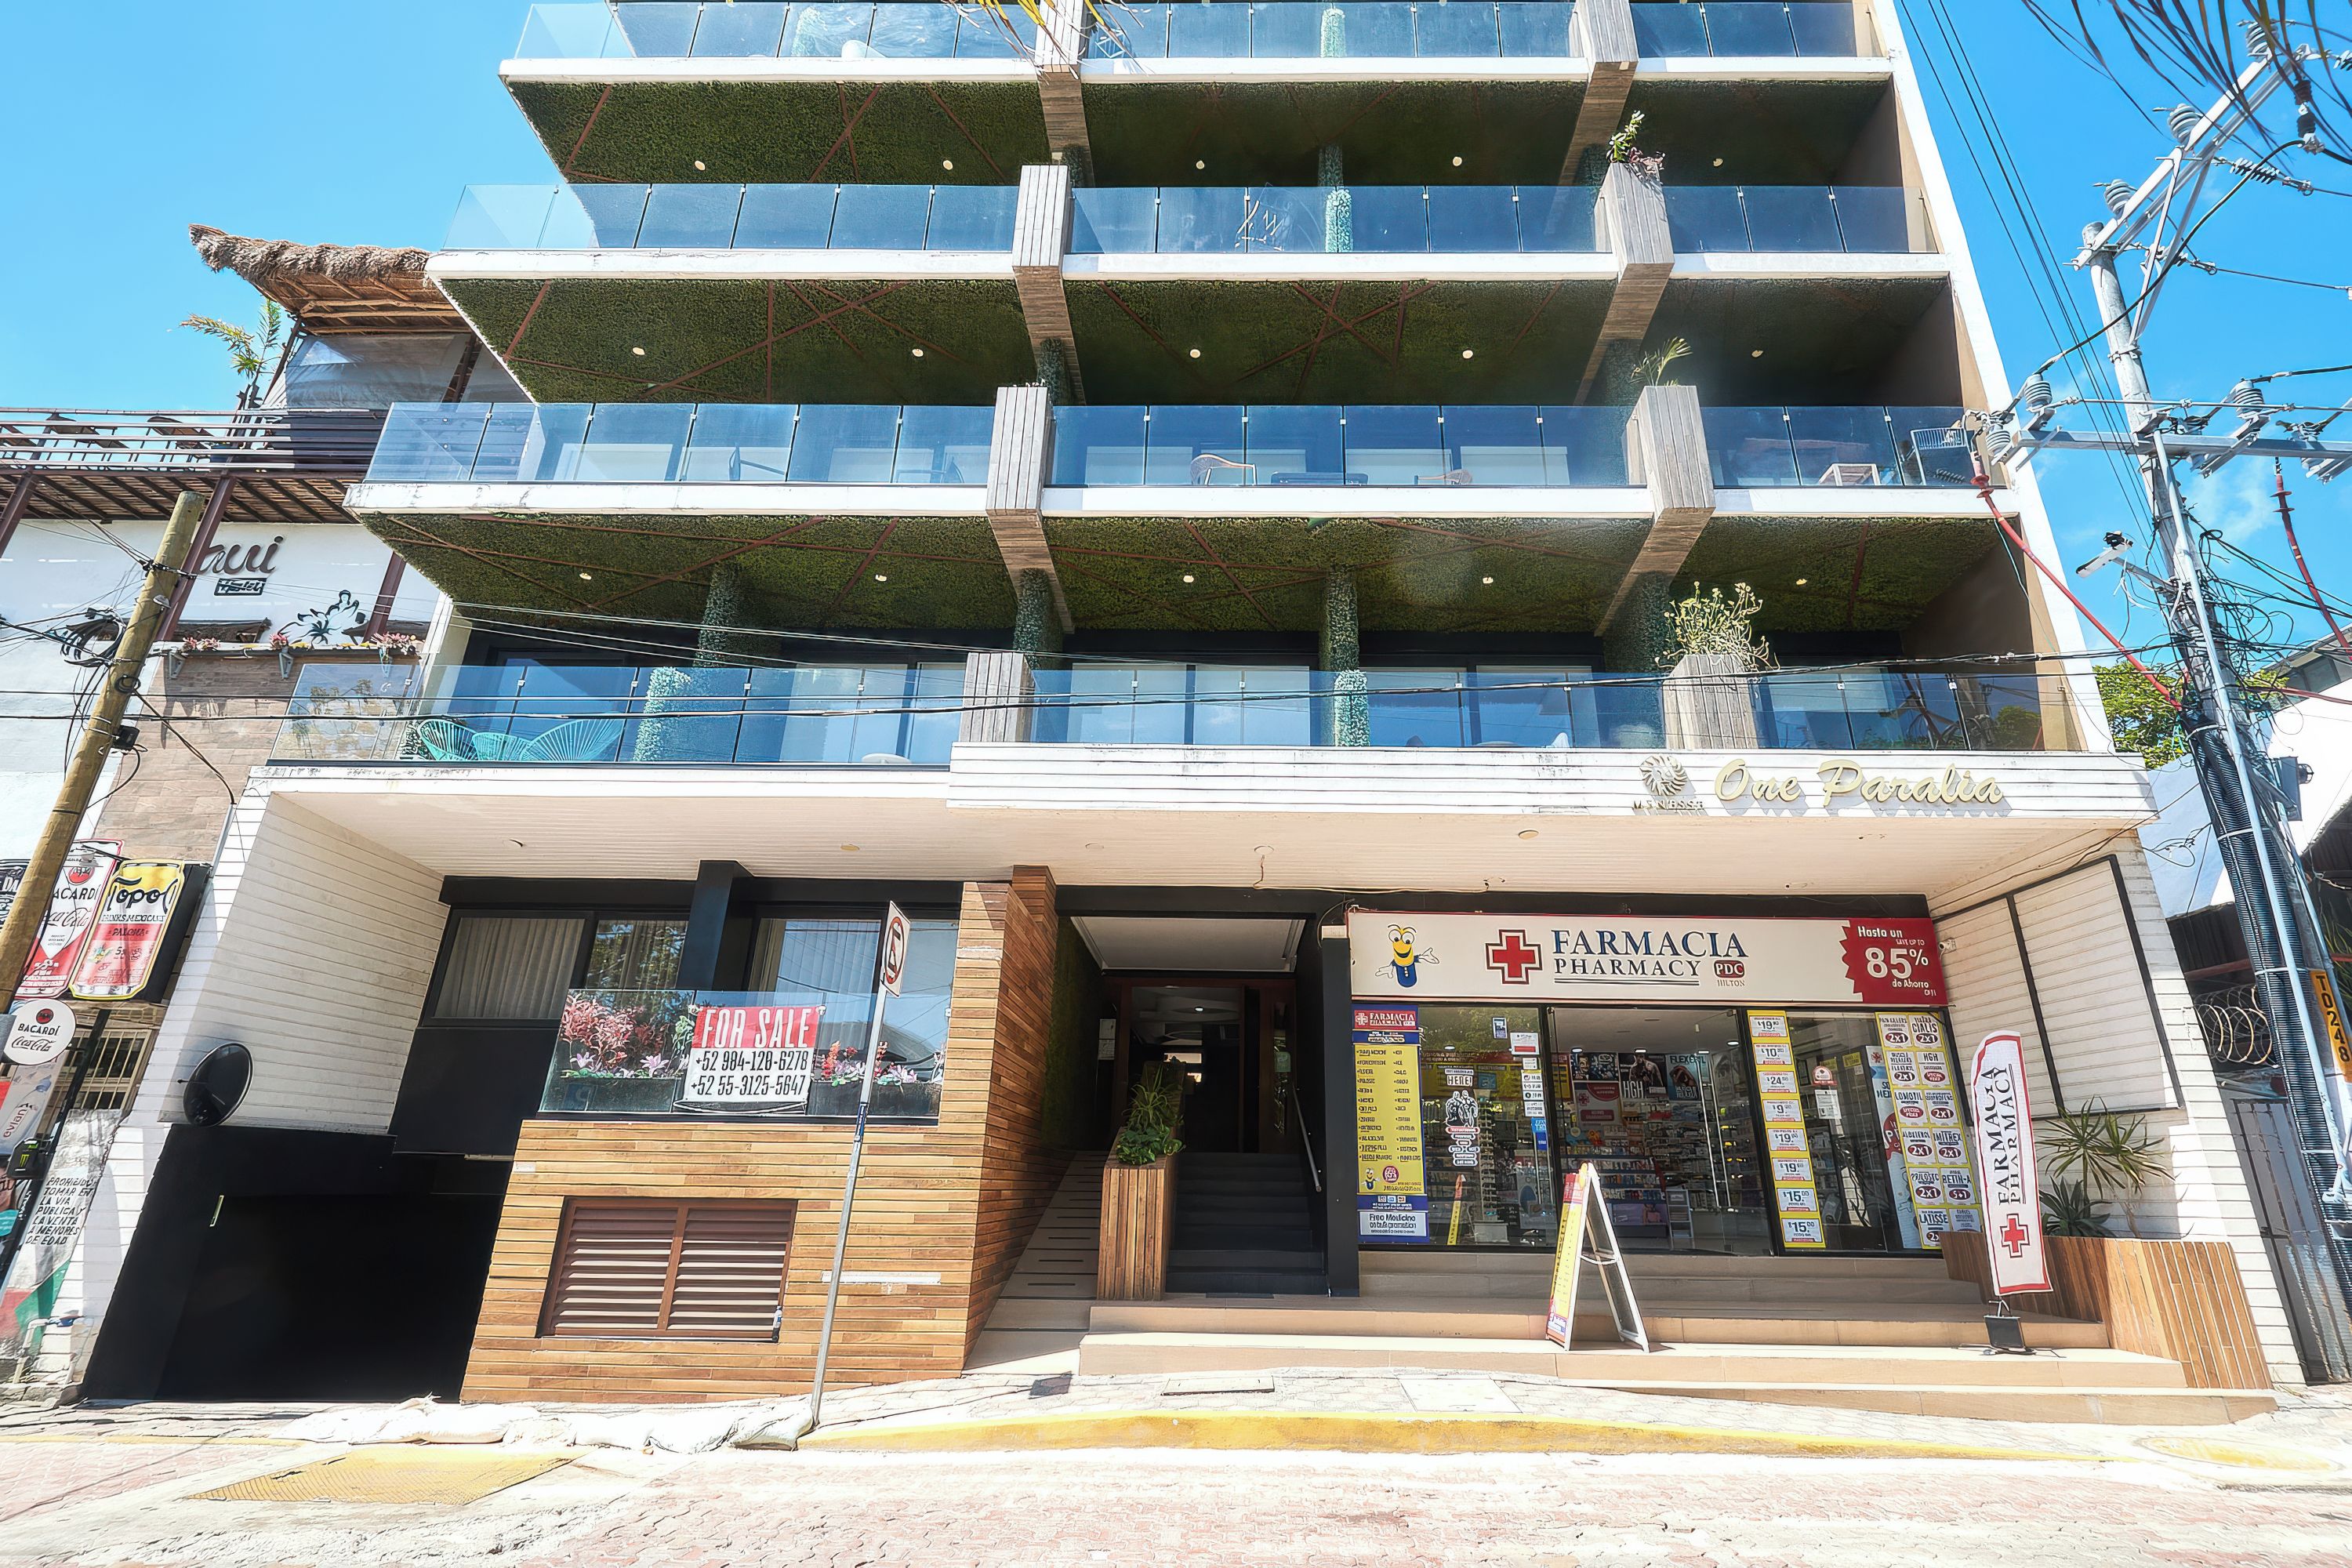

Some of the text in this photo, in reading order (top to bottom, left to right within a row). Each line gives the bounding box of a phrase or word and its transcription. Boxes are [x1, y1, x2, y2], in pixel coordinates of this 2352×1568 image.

[1714, 759, 2003, 807] One Paralia
[53, 884, 100, 901] ACARDÍ
[1857, 926, 1887, 937] Hasta
[1552, 930, 1749, 957] FARMACIA
[1554, 958, 1744, 977] PHARMACY PDC
[1865, 947, 1929, 978] 85%
[17, 1023, 60, 1036] BACARDÍ
[701, 1007, 812, 1048] FOR SALE
[1911, 1022, 1938, 1033] CIALIS
[695, 1051, 719, 1071] +52
[1923, 1053, 1939, 1062] HGH
[691, 1075, 806, 1095] +52 55-3125-5647
[1623, 1080, 1643, 1098] HGH
[1980, 1066, 2010, 1206] FARMACIA
[1993, 1067, 2021, 1204] PHARMACY
[44, 1188, 76, 1196] TOMAR
[39, 1197, 70, 1206] LA VIA
[35, 1206, 74, 1215] PUBLICA
[32, 1216, 78, 1225] LA VENTA
[27, 1225, 80, 1236] A MENORES
[25, 1236, 68, 1245] DE EDAD
